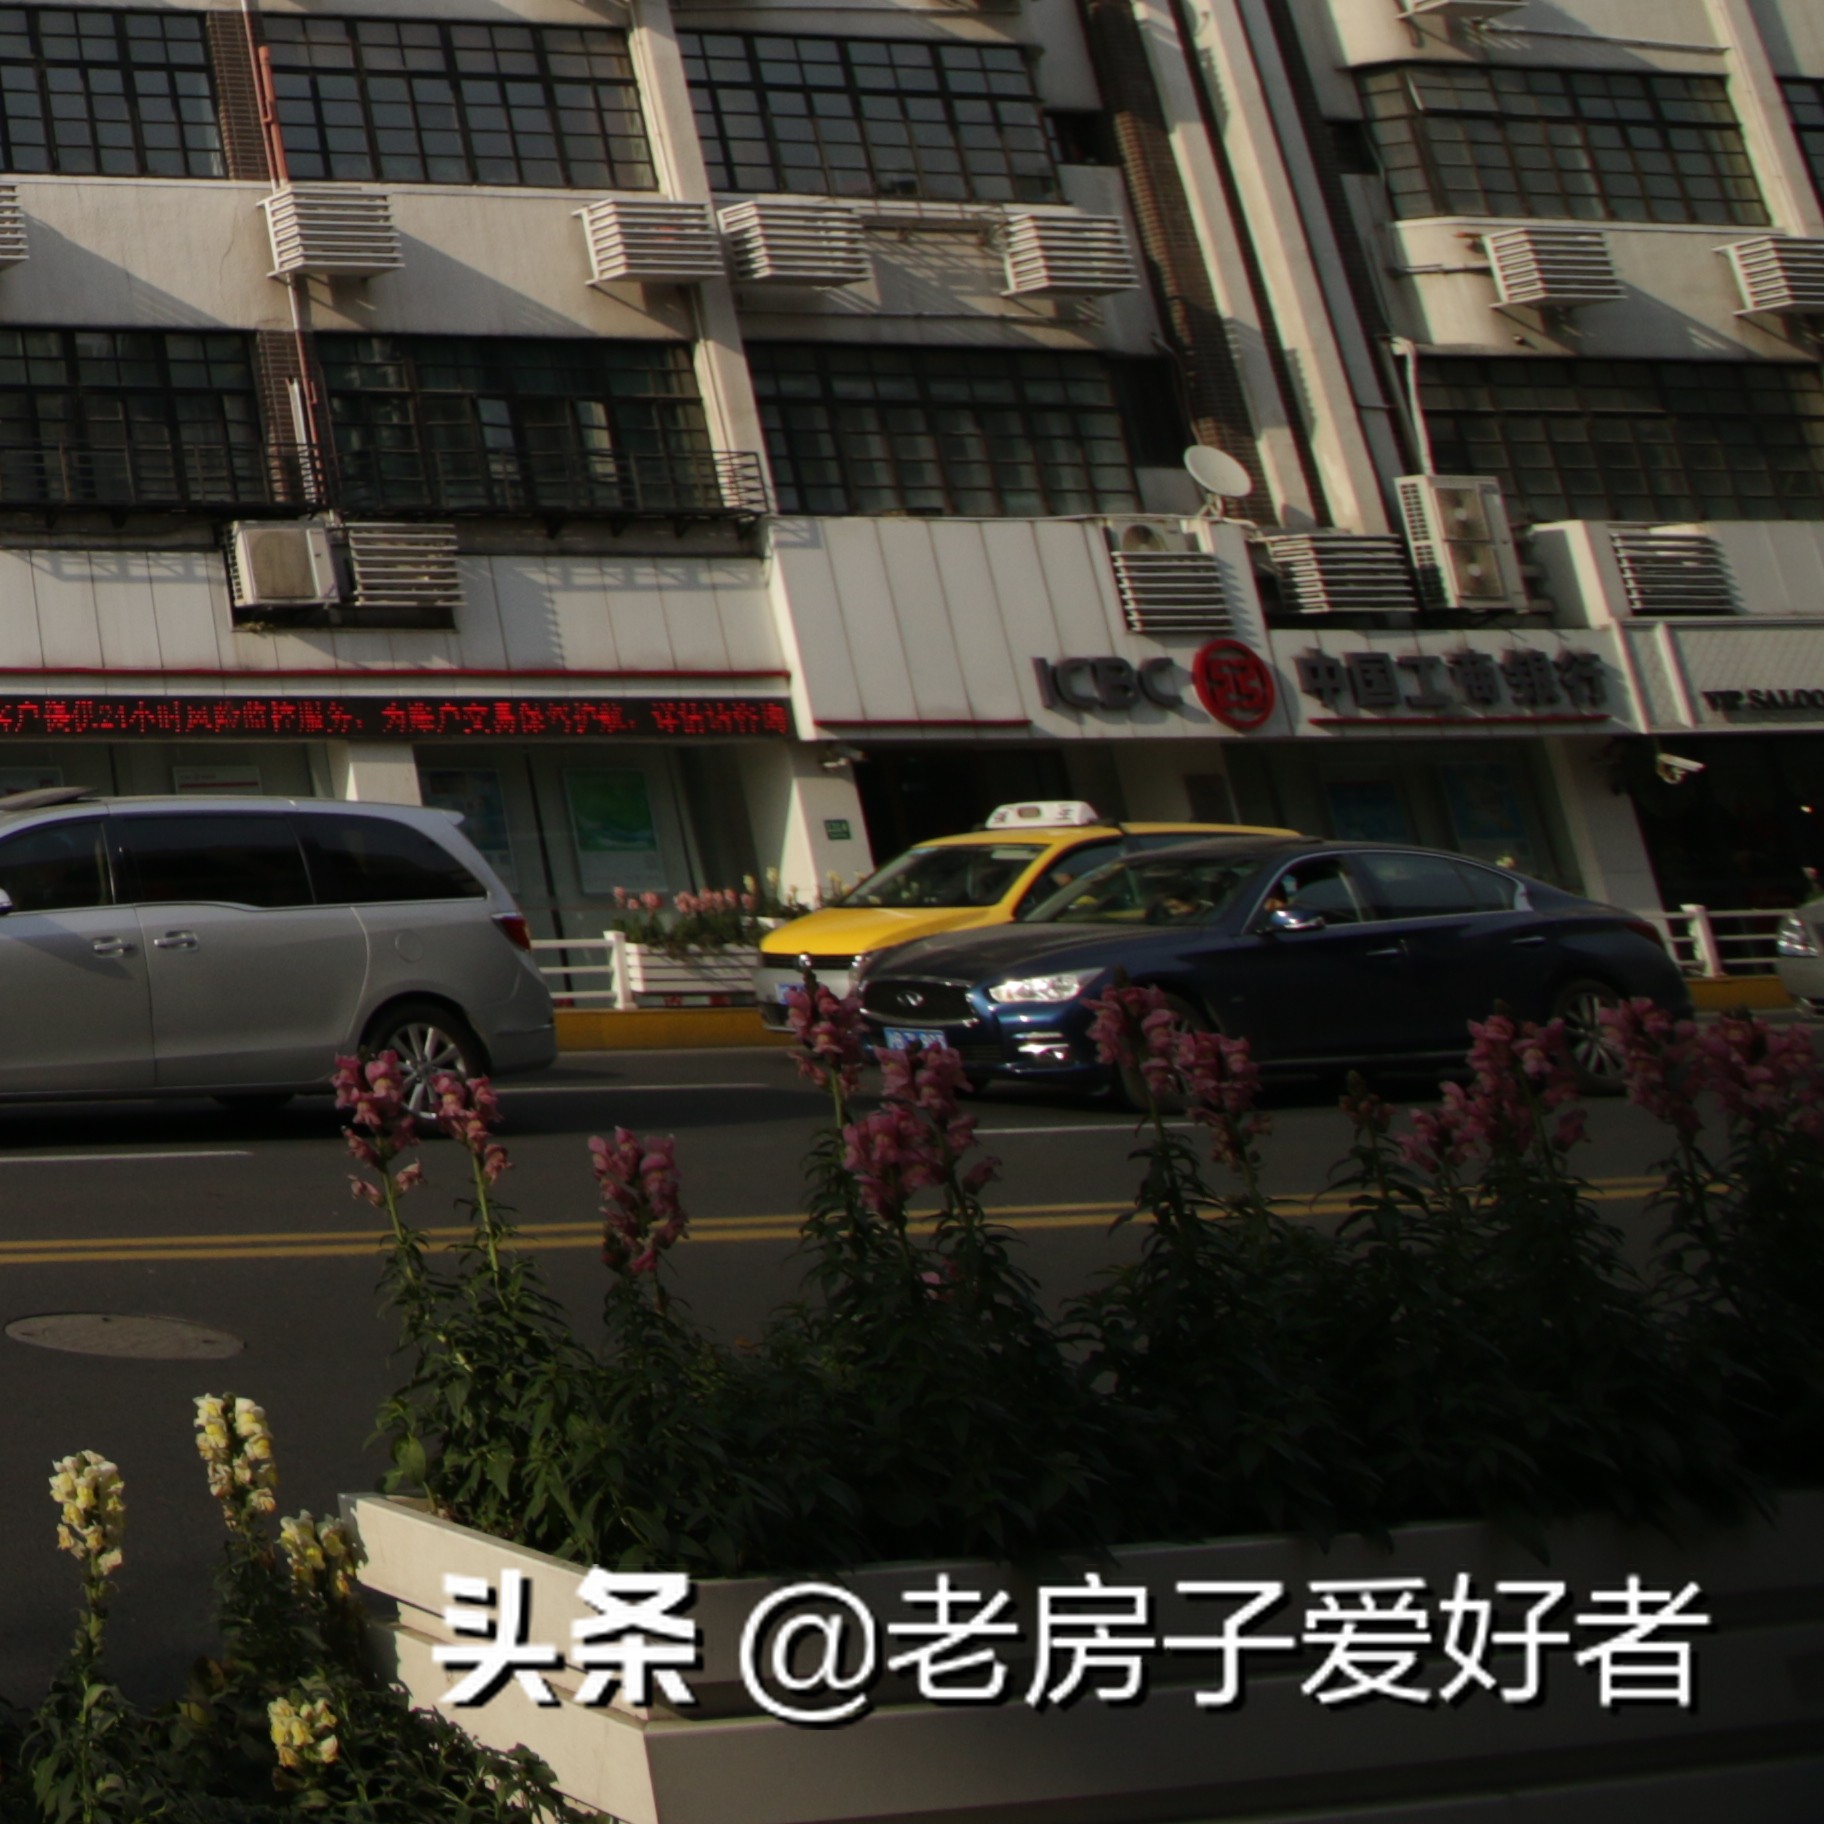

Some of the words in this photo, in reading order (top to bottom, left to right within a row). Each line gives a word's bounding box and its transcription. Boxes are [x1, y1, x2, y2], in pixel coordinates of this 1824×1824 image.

[1031, 656, 1184, 711] ICBC
[1295, 647, 1610, 711] 中国工商银行
